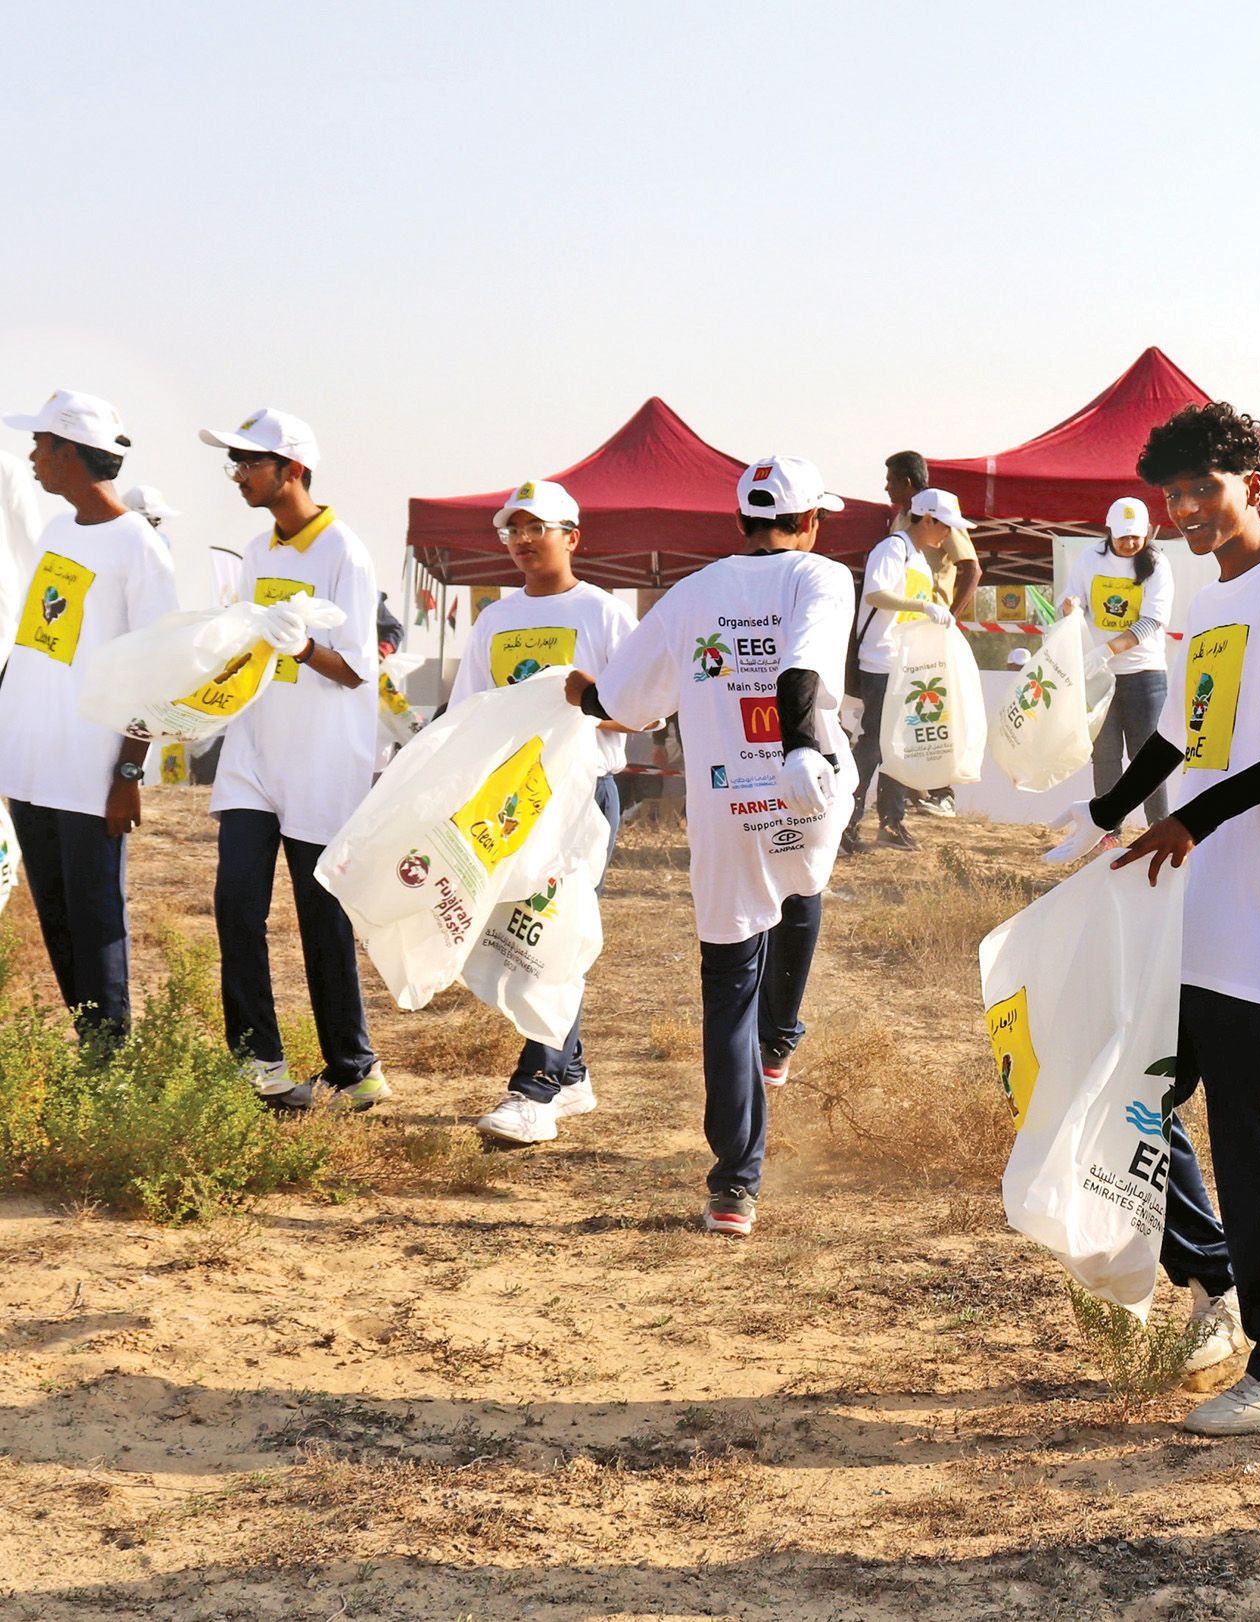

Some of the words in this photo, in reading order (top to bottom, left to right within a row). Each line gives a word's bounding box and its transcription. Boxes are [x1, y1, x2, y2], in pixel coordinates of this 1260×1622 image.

[718, 615, 769, 630] Organised
[736, 637, 777, 656] EEG
[727, 681, 752, 692] Main
[202, 687, 234, 709] UAE
[914, 725, 949, 743] EEG
[740, 749, 784, 760] Co-Spon
[730, 799, 788, 815] FARNEK
[743, 819, 783, 832] Support
[786, 812, 826, 826] Sponsor
[470, 820, 495, 853] Clean
[768, 844, 806, 855] CANPACK
[434, 876, 473, 931] Fujairah
[433, 900, 465, 945] Plastic
[506, 907, 544, 947] EEG
[991, 1009, 1018, 1036] الإمارا
[1128, 1140, 1170, 1193] EE
[1083, 1178, 1135, 1211] EMIRATES
[1135, 1204, 1167, 1235] ENVIRON
[1130, 1216, 1153, 1237] GROUP
